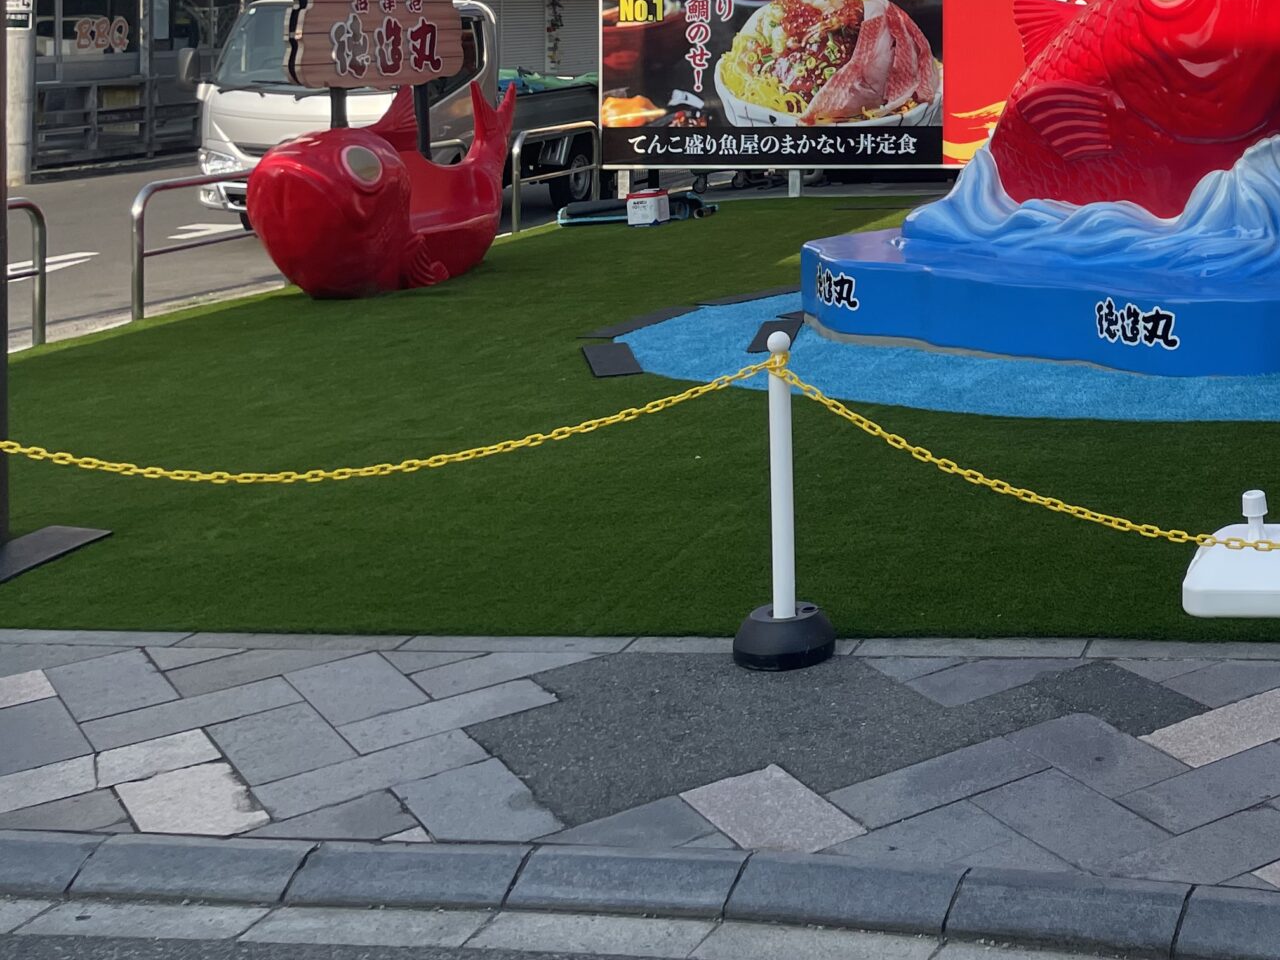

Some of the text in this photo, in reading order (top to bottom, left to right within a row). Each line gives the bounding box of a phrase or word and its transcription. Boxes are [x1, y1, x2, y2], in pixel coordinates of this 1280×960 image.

[73, 16, 130, 52] BBQ
[627, 132, 918, 157] てんこ盛り魚屋のまかない丼定食
